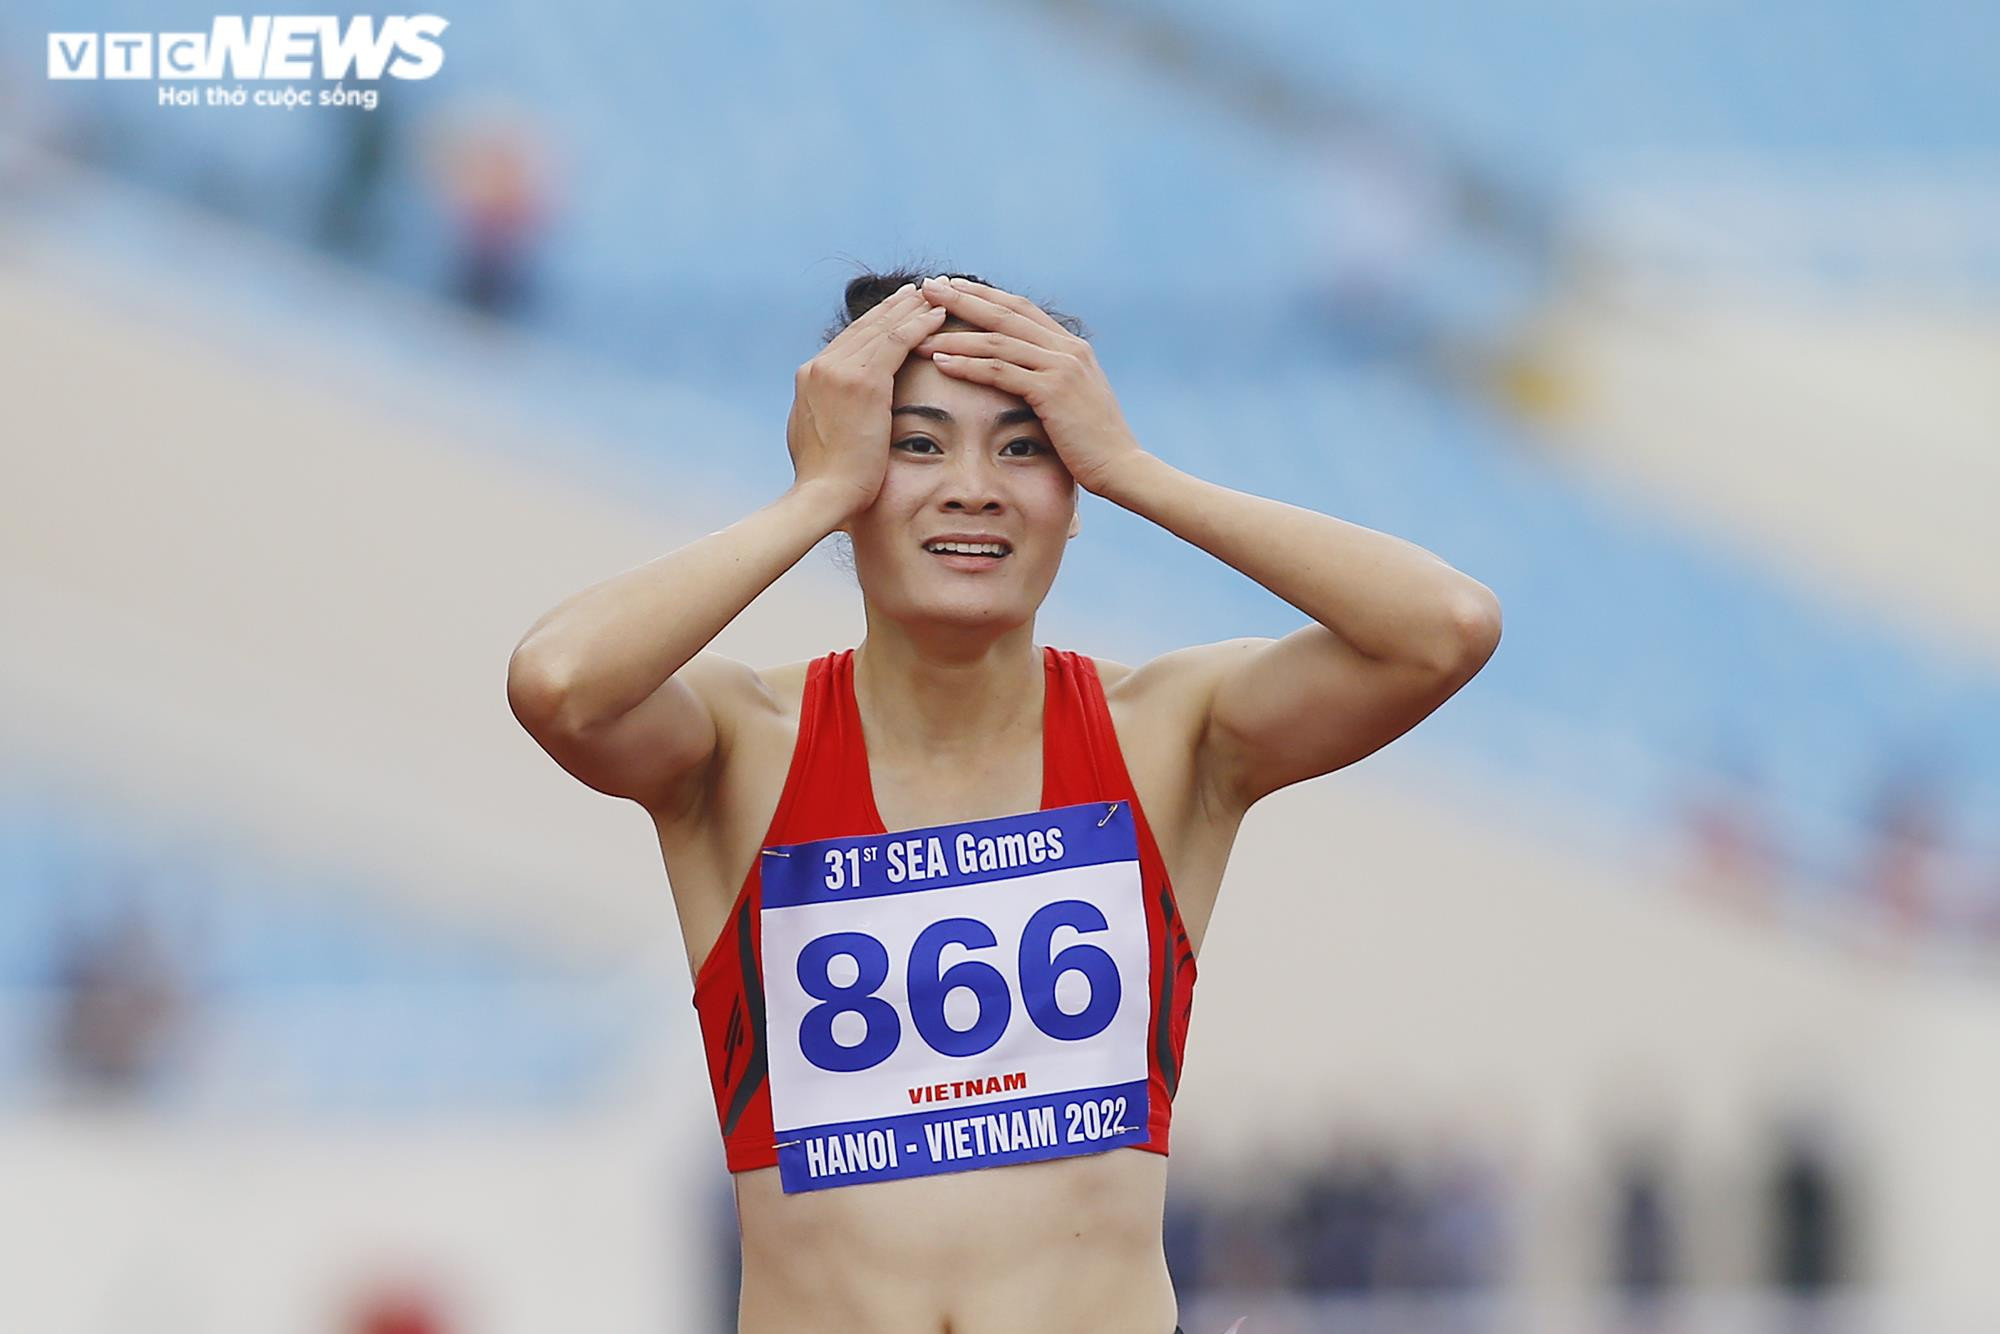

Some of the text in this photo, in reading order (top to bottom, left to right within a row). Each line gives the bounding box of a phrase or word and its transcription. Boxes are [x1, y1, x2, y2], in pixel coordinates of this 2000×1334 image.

[886, 837, 949, 883] SEA
[955, 827, 1065, 875] Games
[796, 899, 1122, 1073] 866
[908, 1072, 1027, 1105] VIETNAM
[805, 1128, 898, 1178] HANOI
[923, 1106, 1058, 1163] VIETNAM
[1064, 1096, 1128, 1143] 2022
